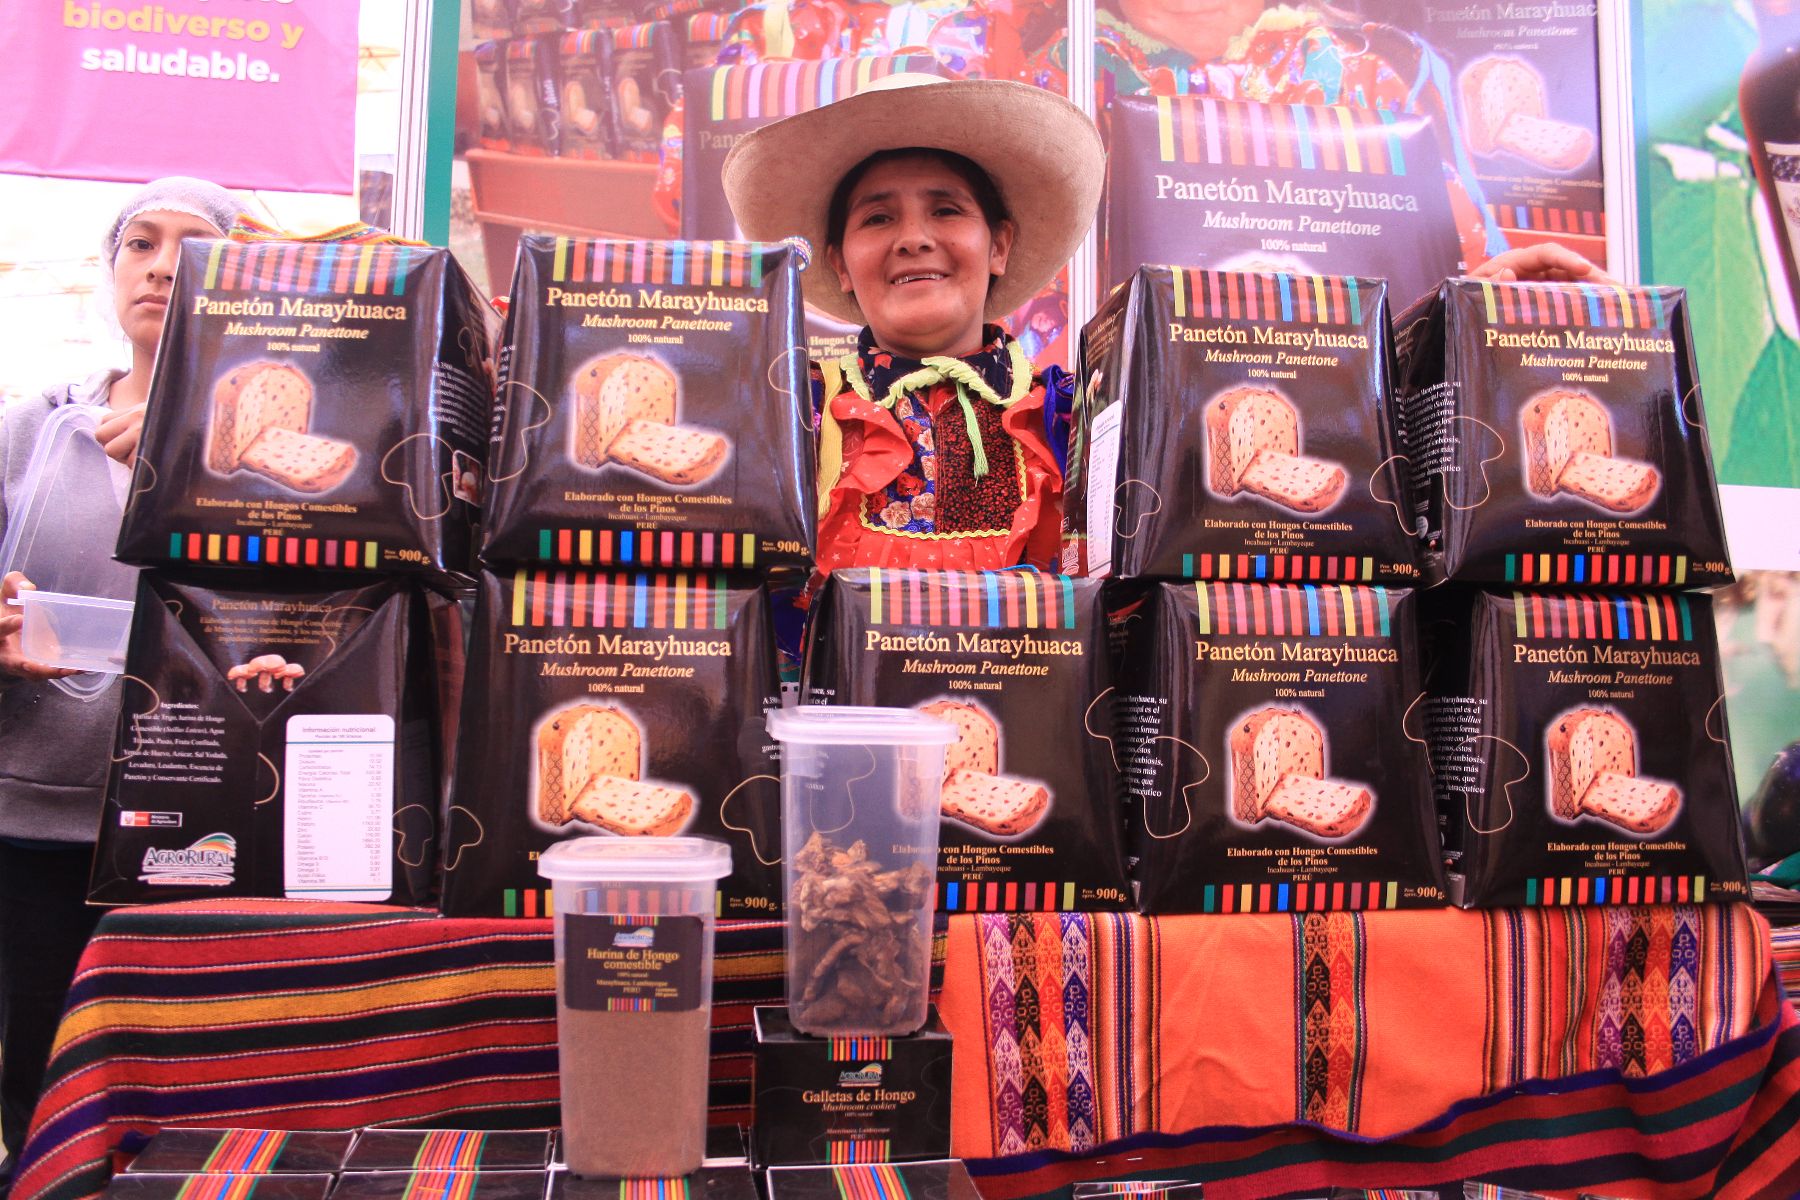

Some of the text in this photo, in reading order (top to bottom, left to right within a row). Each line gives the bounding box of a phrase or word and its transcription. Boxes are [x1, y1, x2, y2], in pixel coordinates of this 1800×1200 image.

[1425, 2, 1599, 22] Panetón Marayhuac
[63, 1, 304, 49] biodiverso y
[80, 44, 280, 83] saludable.
[1155, 175, 1419, 213] Panetón Marayhuaca
[1203, 210, 1381, 235] Mushroom Panettone
[1261, 239, 1327, 253] 100% natural
[546, 287, 769, 315] Panetón Marayhuaca
[193, 296, 406, 322] Panetón Marayhuaca
[582, 314, 733, 331] Mushroom Panettone
[225, 322, 370, 339] Mushroom Panettone
[628, 334, 683, 344] 100% natural
[810, 335, 844, 347] Hongos
[1169, 324, 1368, 350] Panetón Marayhuaca
[1484, 330, 1675, 354] Panetón Marayhuaca
[267, 343, 290, 351] 100%
[824, 347, 849, 356] Pinos
[1205, 349, 1338, 367] Mushroom Panettone
[1520, 354, 1647, 370] Mushroom Panettone
[1248, 369, 1296, 379] 100% natural
[1562, 373, 1608, 382] 100% natural
[564, 492, 615, 502] Elaborado
[637, 493, 672, 505] Hongos
[675, 494, 732, 505] Comestibles
[196, 498, 244, 509] Elaborado
[265, 501, 299, 511] Hongos
[302, 503, 357, 513] Comestibles
[620, 504, 676, 513] de los Pinos
[248, 511, 302, 520] de los Pinos
[1204, 519, 1249, 529] Elaborado
[1269, 521, 1300, 531] Hongos
[1302, 522, 1353, 531] Comestibles
[1525, 520, 1568, 528] Elaborado
[1586, 520, 1616, 530] Hongos
[1618, 521, 1667, 529] Comestibles
[1255, 531, 1304, 539] de los Pinos
[1598, 529, 1620, 538] Pinos
[777, 541, 799, 552] 900
[399, 550, 421, 561] 900
[1392, 563, 1412, 574] 900
[1705, 562, 1724, 572] 900
[212, 599, 257, 611] Panetón
[504, 633, 732, 661] Panetón Marayhuaca
[865, 630, 1083, 659] Panetón Marayhuaca
[1195, 641, 1399, 666] Panetón Marayhuaca
[1513, 644, 1700, 669] Panetón Marayhuaca
[540, 662, 695, 678] Mushroom Panettone
[902, 659, 1048, 676] Mushroom Panettone
[1231, 668, 1367, 682] Mushroom Panettone
[1547, 671, 1673, 685] Mushroom Panettone
[588, 684, 644, 693] 100% natural
[948, 680, 1002, 690] 100% natural
[1275, 688, 1325, 697] 100% natural
[1588, 690, 1634, 698] 100% natural
[943, 846, 960, 854] con
[962, 844, 997, 855] Hongos
[999, 845, 1054, 855] Comestibles
[1227, 848, 1273, 857] Elaborado
[1292, 848, 1325, 857] Hongos
[1327, 846, 1378, 855] Comestibles
[1547, 842, 1589, 851] Elaborado
[1608, 842, 1637, 852] Hongos
[1639, 842, 1686, 850] Comestibles
[947, 856, 1000, 865] de los Pinos
[1278, 857, 1328, 866] de los Pinos
[1606, 852, 1617, 860] los
[1619, 852, 1641, 861] Pinos
[1417, 887, 1437, 897] 900
[1723, 882, 1740, 892] 900
[1097, 888, 1117, 899] 900
[745, 896, 768, 908] 900
[587, 948, 679, 963] Harina de Hongo
[604, 960, 661, 970] comestible
[803, 1089, 916, 1104] Galletas de Hongo
[822, 1102, 896, 1111] Mushroom cookies
